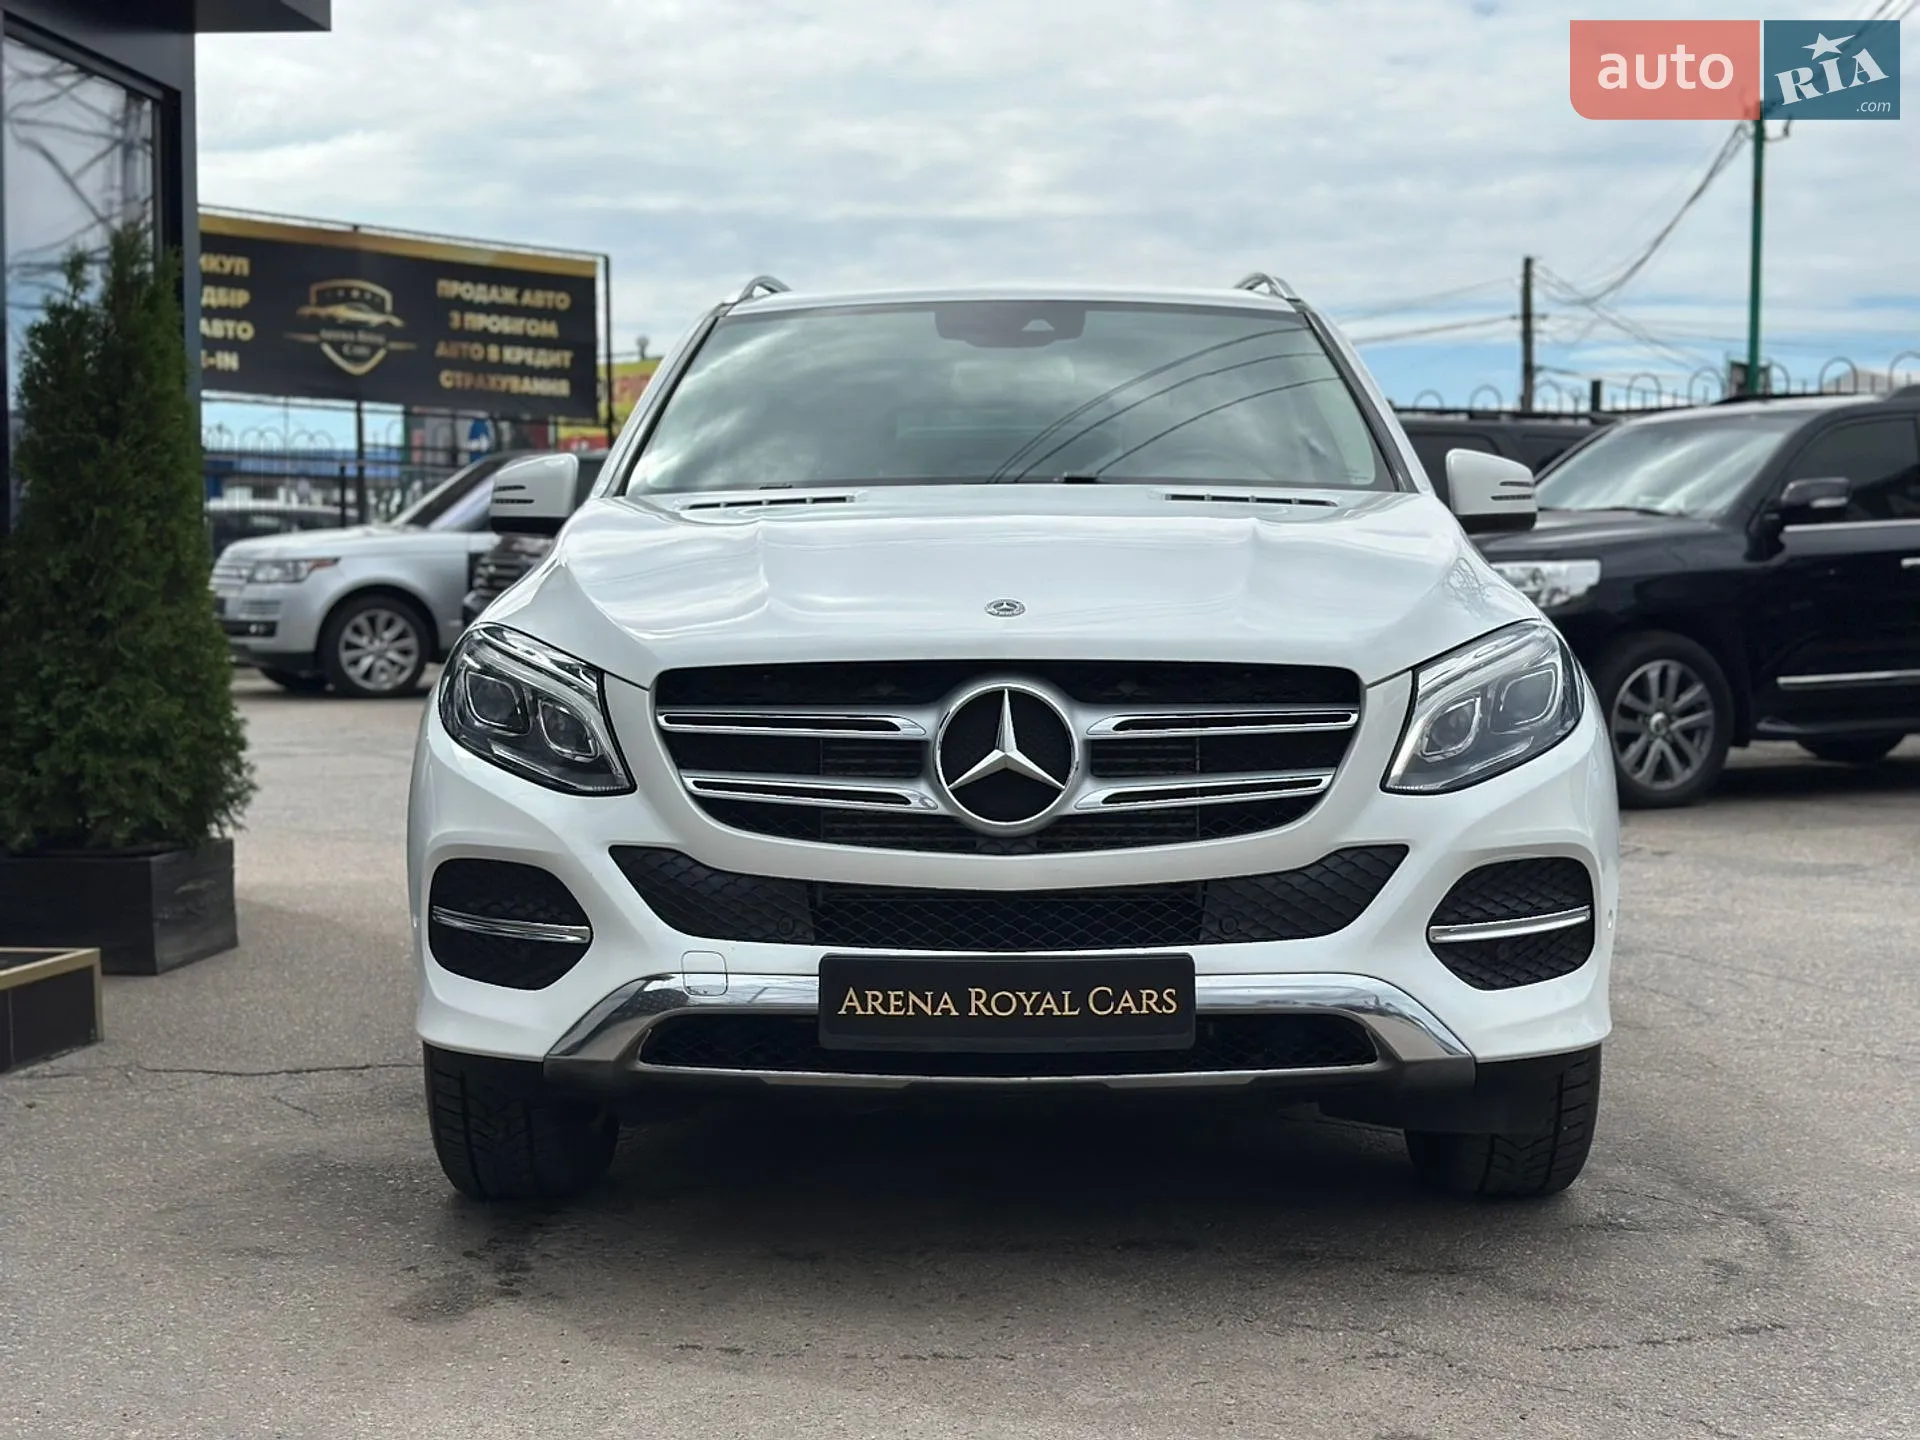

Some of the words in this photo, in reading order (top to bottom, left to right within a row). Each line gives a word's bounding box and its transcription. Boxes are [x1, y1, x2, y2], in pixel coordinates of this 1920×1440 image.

[437, 279, 519, 305] ПРОДАЖ
[521, 289, 571, 311] АВТО
[463, 312, 559, 339] ПРОБІГОМ
[434, 341, 486, 361] АВТО
[502, 345, 574, 369] КРЕДИТ
[439, 370, 571, 397] СТРАХУВАННЯ
[838, 987, 960, 1016] ARENA
[968, 987, 1081, 1017] ROYAL
[1088, 986, 1178, 1015] CARS
